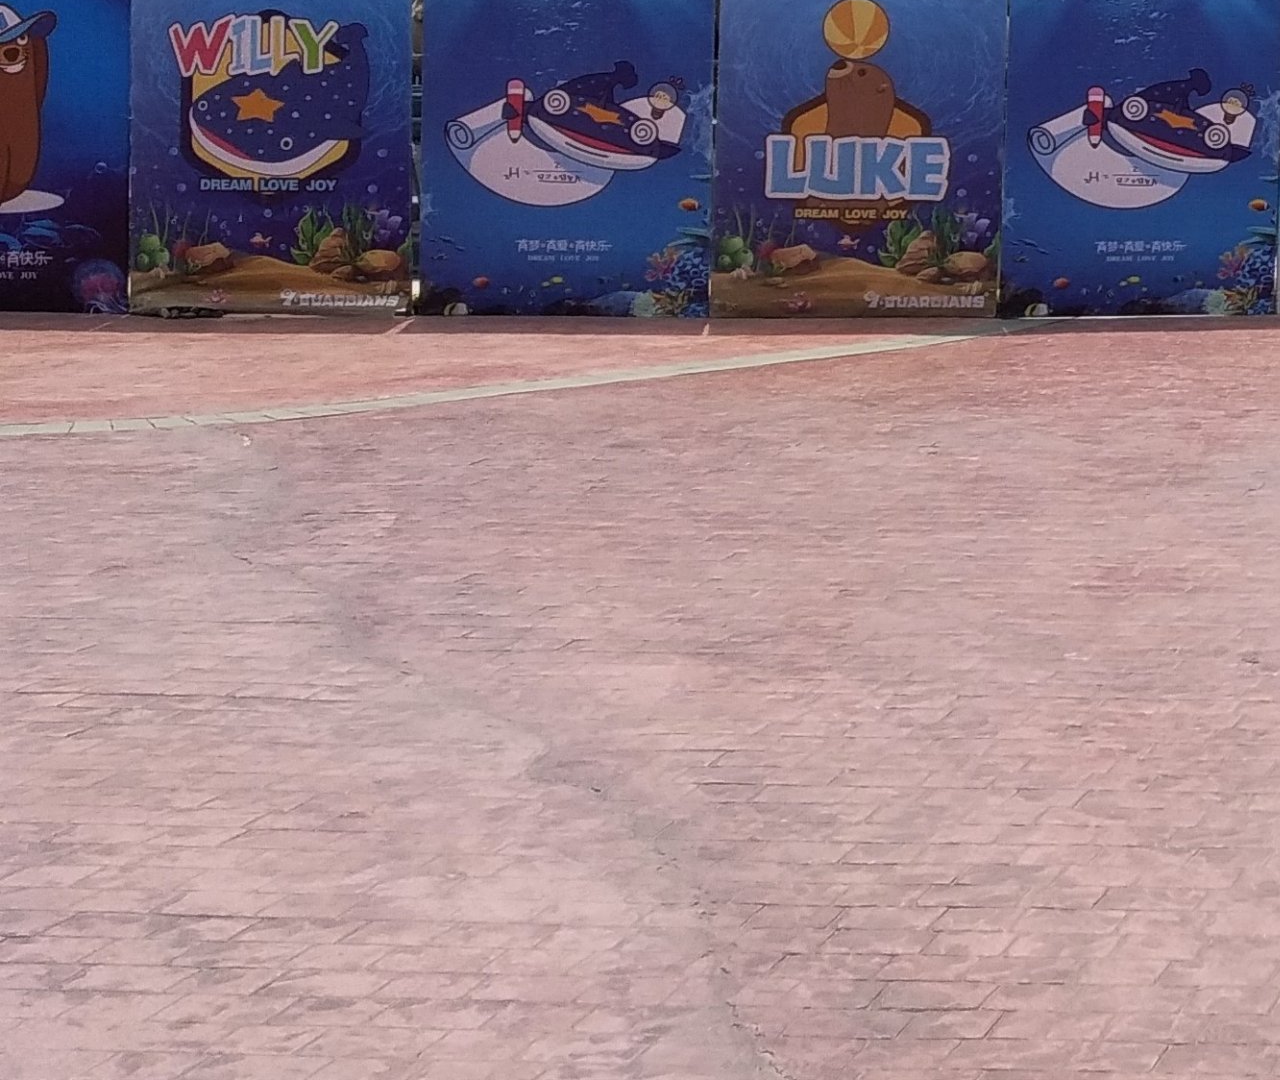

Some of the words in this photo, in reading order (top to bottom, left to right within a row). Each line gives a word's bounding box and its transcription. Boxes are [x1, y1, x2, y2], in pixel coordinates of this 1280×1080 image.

[168, 14, 340, 77] WILLY
[764, 134, 951, 201] LUKE
[200, 179, 251, 191] DREAM
[259, 179, 300, 191] LOVE
[305, 179, 337, 191] JOY
[794, 208, 839, 219] DREAM
[845, 208, 877, 219] LOVE
[882, 209, 908, 220] JOY
[20, 271, 37, 280] JOY
